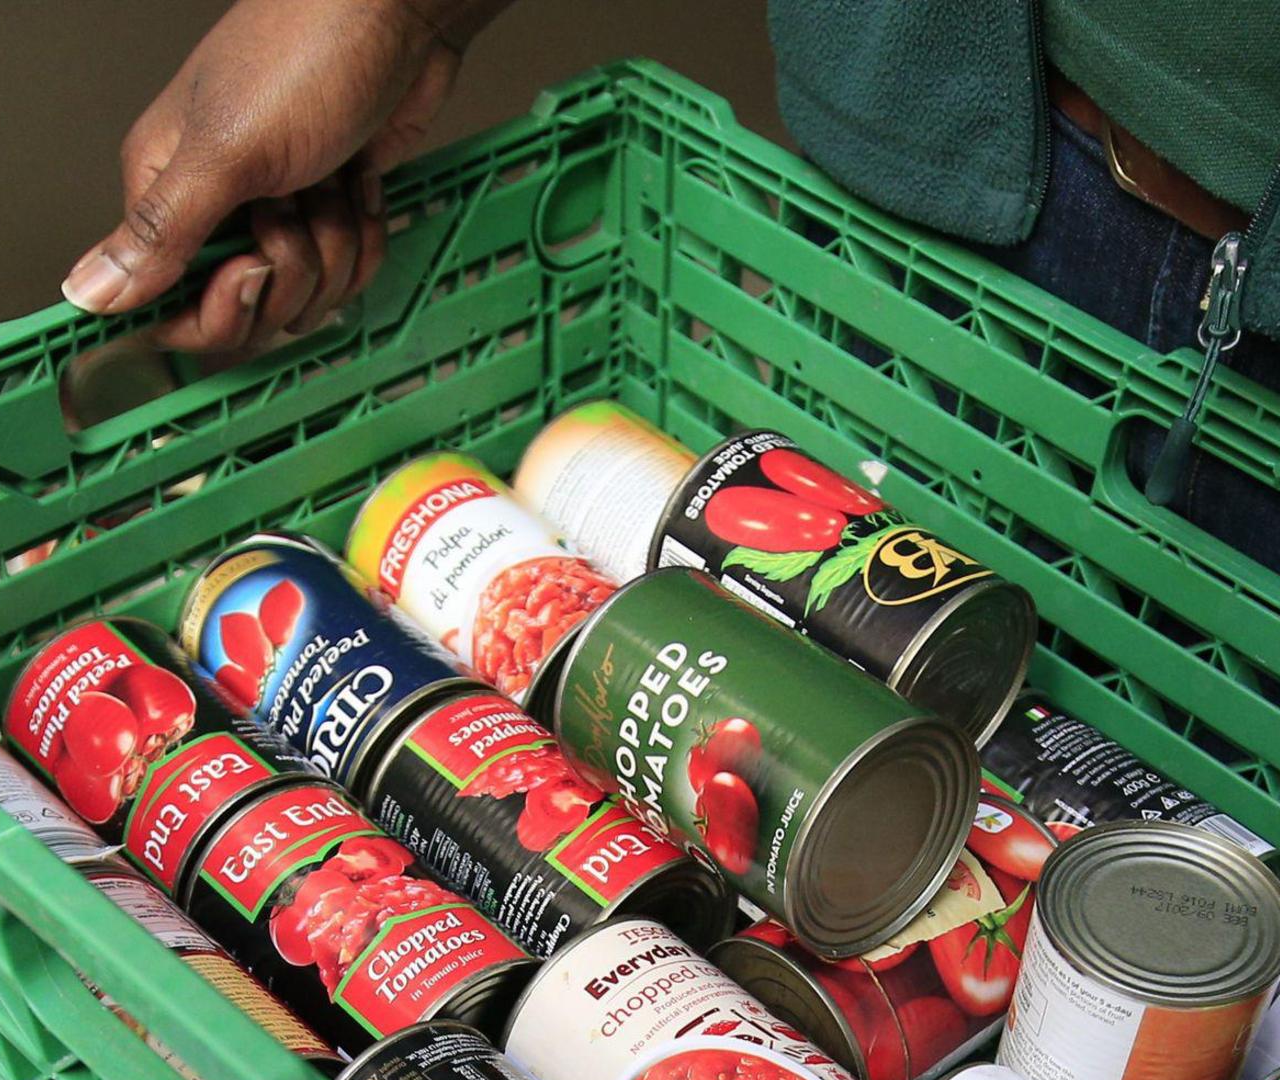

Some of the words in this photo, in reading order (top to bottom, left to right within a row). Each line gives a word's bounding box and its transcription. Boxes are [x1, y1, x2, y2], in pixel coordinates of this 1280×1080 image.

[714, 442, 745, 465] JUICE
[684, 446, 763, 520] TOMATOES
[380, 480, 484, 584] FRESHONA
[423, 524, 473, 569] Polpa
[430, 587, 448, 611] di
[447, 523, 513, 590] pomodori
[28, 646, 111, 736] Tomatoes
[67, 653, 133, 706] Peeled
[267, 634, 330, 728] Tomatoe
[298, 627, 370, 705] Peeled
[39, 701, 70, 758] Plum
[281, 701, 304, 738] Plu
[642, 650, 728, 835] OMATOES
[178, 753, 254, 806] East
[1122, 779, 1151, 797] 400g
[780, 787, 805, 830] JUICE
[143, 803, 188, 872] End
[220, 821, 289, 885] East
[283, 796, 352, 827] End
[581, 832, 653, 884] End
[767, 827, 786, 880] TOMATO
[766, 879, 776, 895] IN
[367, 911, 463, 981] Chopped
[545, 913, 571, 961] Choppe
[375, 928, 486, 1004] Tomatoes
[410, 988, 423, 1001] in
[421, 960, 459, 990] Tomato
[460, 948, 485, 968] Juice
[583, 944, 693, 1001] Everyday
[600, 964, 698, 1038] chopped
[653, 985, 699, 1015] Produced
[629, 1041, 645, 1055] No
[645, 1006, 684, 1042] artificial
